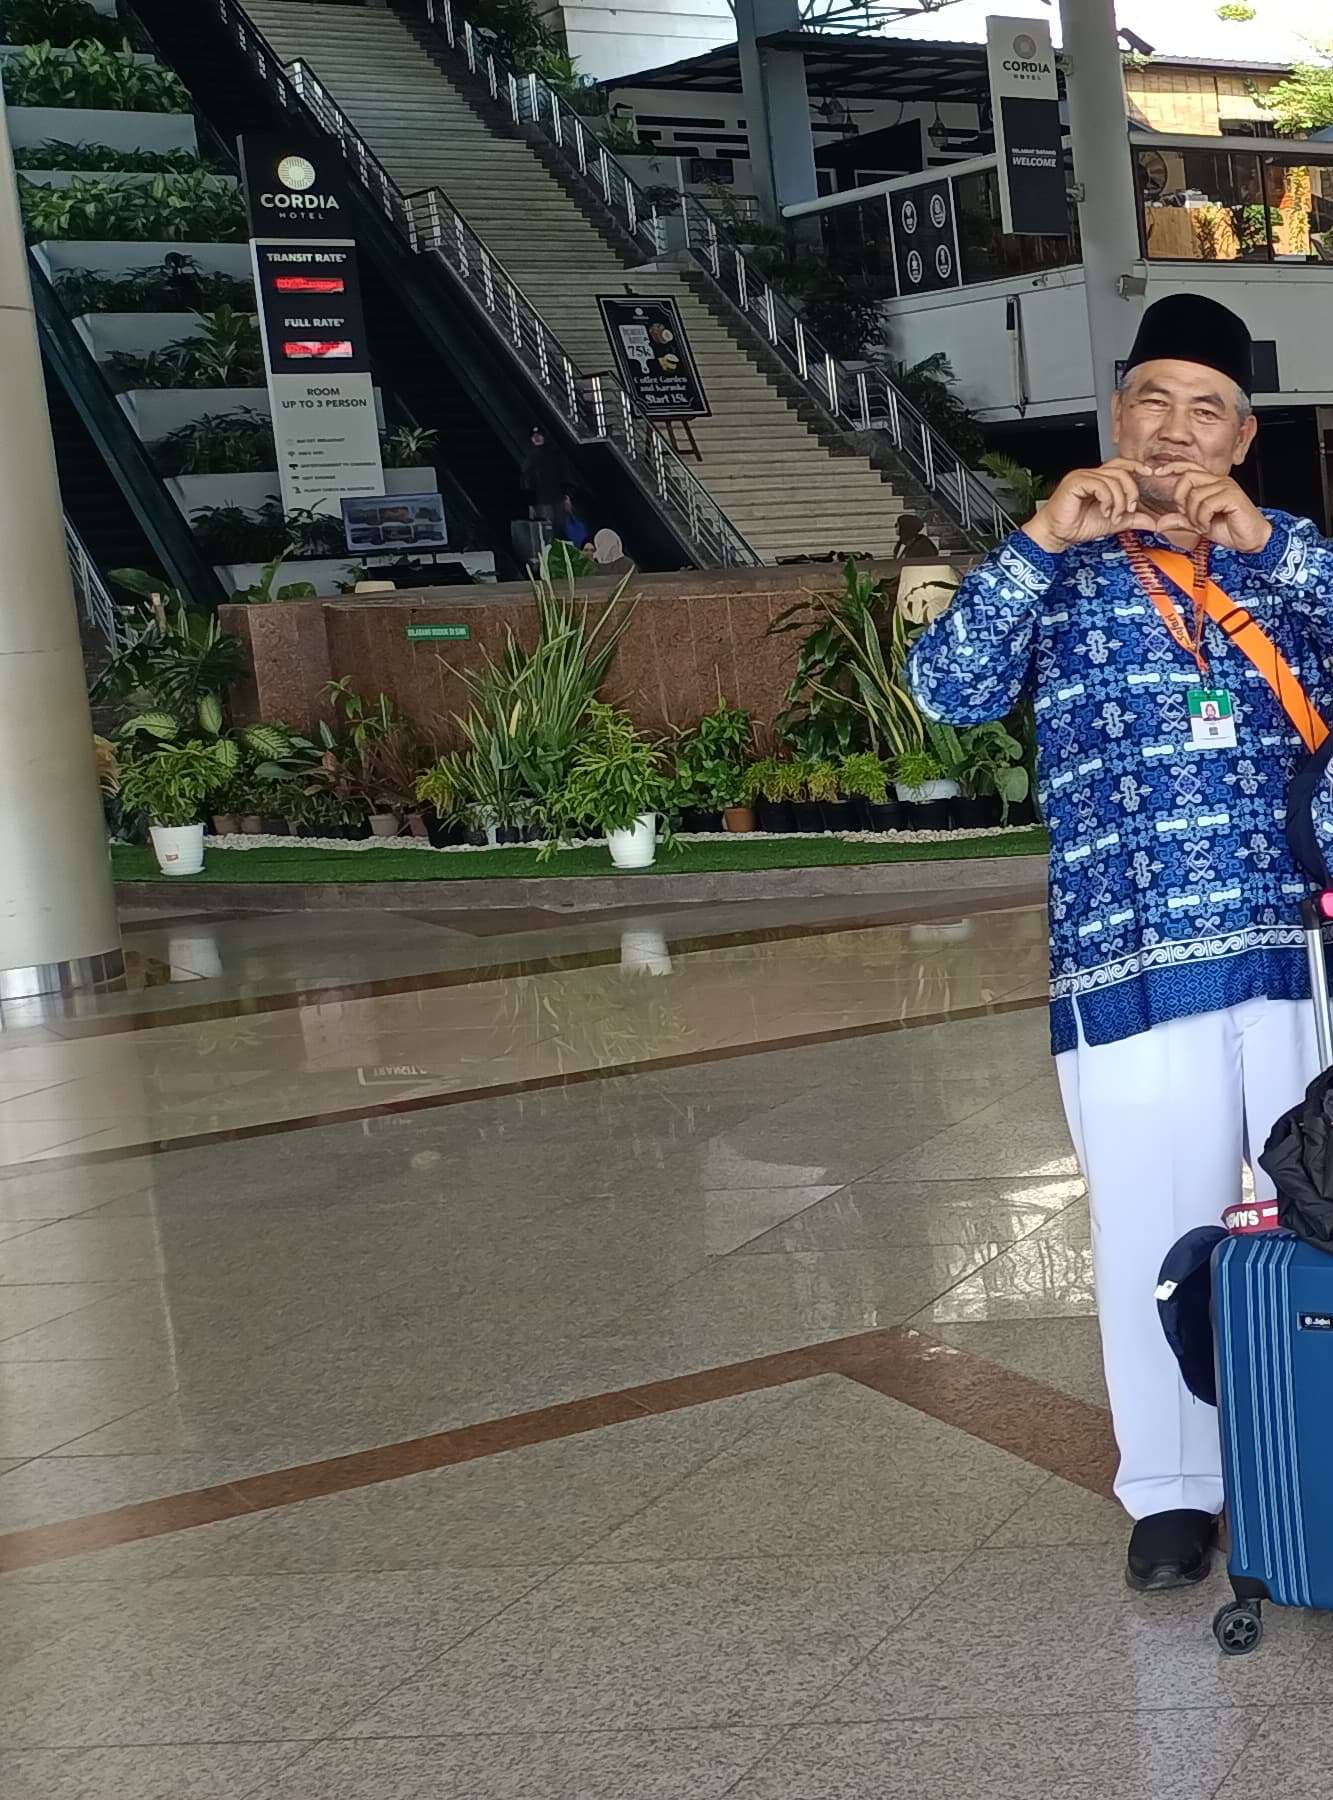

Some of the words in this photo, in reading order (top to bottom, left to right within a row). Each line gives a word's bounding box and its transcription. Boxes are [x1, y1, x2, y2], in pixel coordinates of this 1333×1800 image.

[1003, 60, 1051, 74] CORDIA
[1012, 156, 1057, 168] WELCOME
[260, 193, 340, 210] CORDIA
[278, 212, 325, 220] HOTEL
[266, 253, 313, 263] TRANSIT
[284, 318, 311, 328] FULL
[306, 388, 340, 396] ROOM
[282, 400, 296, 408] UP
[299, 400, 313, 409] TO
[315, 400, 323, 408] 3
[325, 399, 367, 408] PERSON
